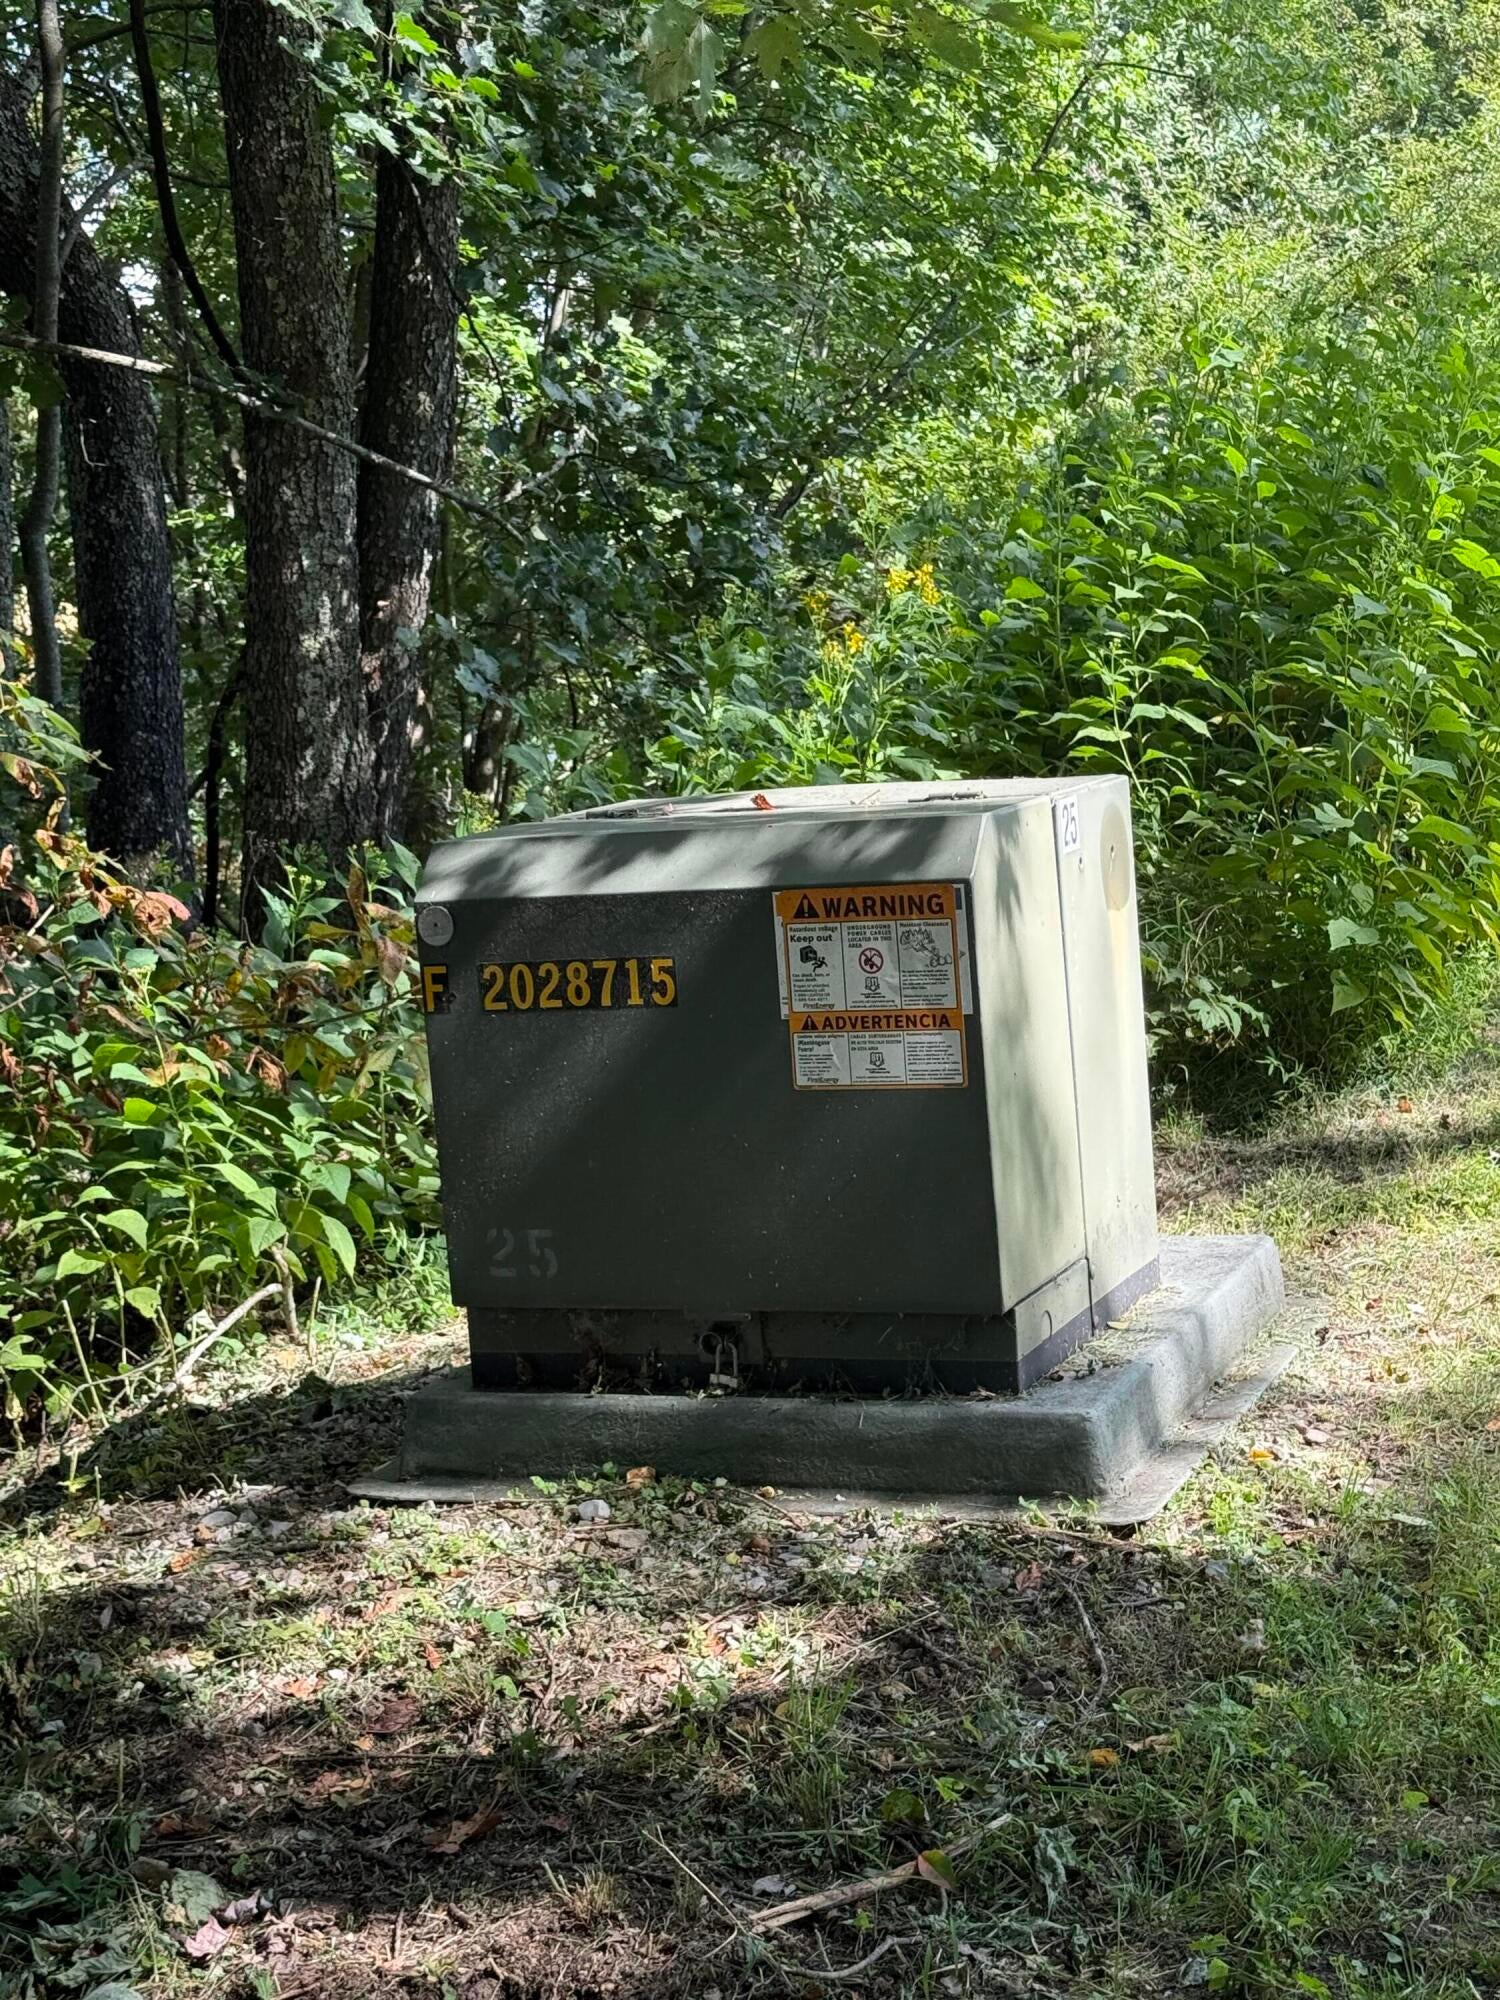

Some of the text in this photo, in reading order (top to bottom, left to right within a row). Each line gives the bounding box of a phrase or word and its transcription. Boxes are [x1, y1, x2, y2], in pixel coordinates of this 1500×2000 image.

[1062, 802, 1077, 847] 25
[822, 893, 944, 918] WARNING
[789, 925, 838, 933] Hazardous voltage
[790, 934, 832, 944] Keep out
[423, 958, 675, 1012] F 2028715
[803, 1002, 835, 1010] FirstEnergy
[821, 1014, 951, 1031] ADVERTENCIA
[486, 1228, 558, 1279] 25
